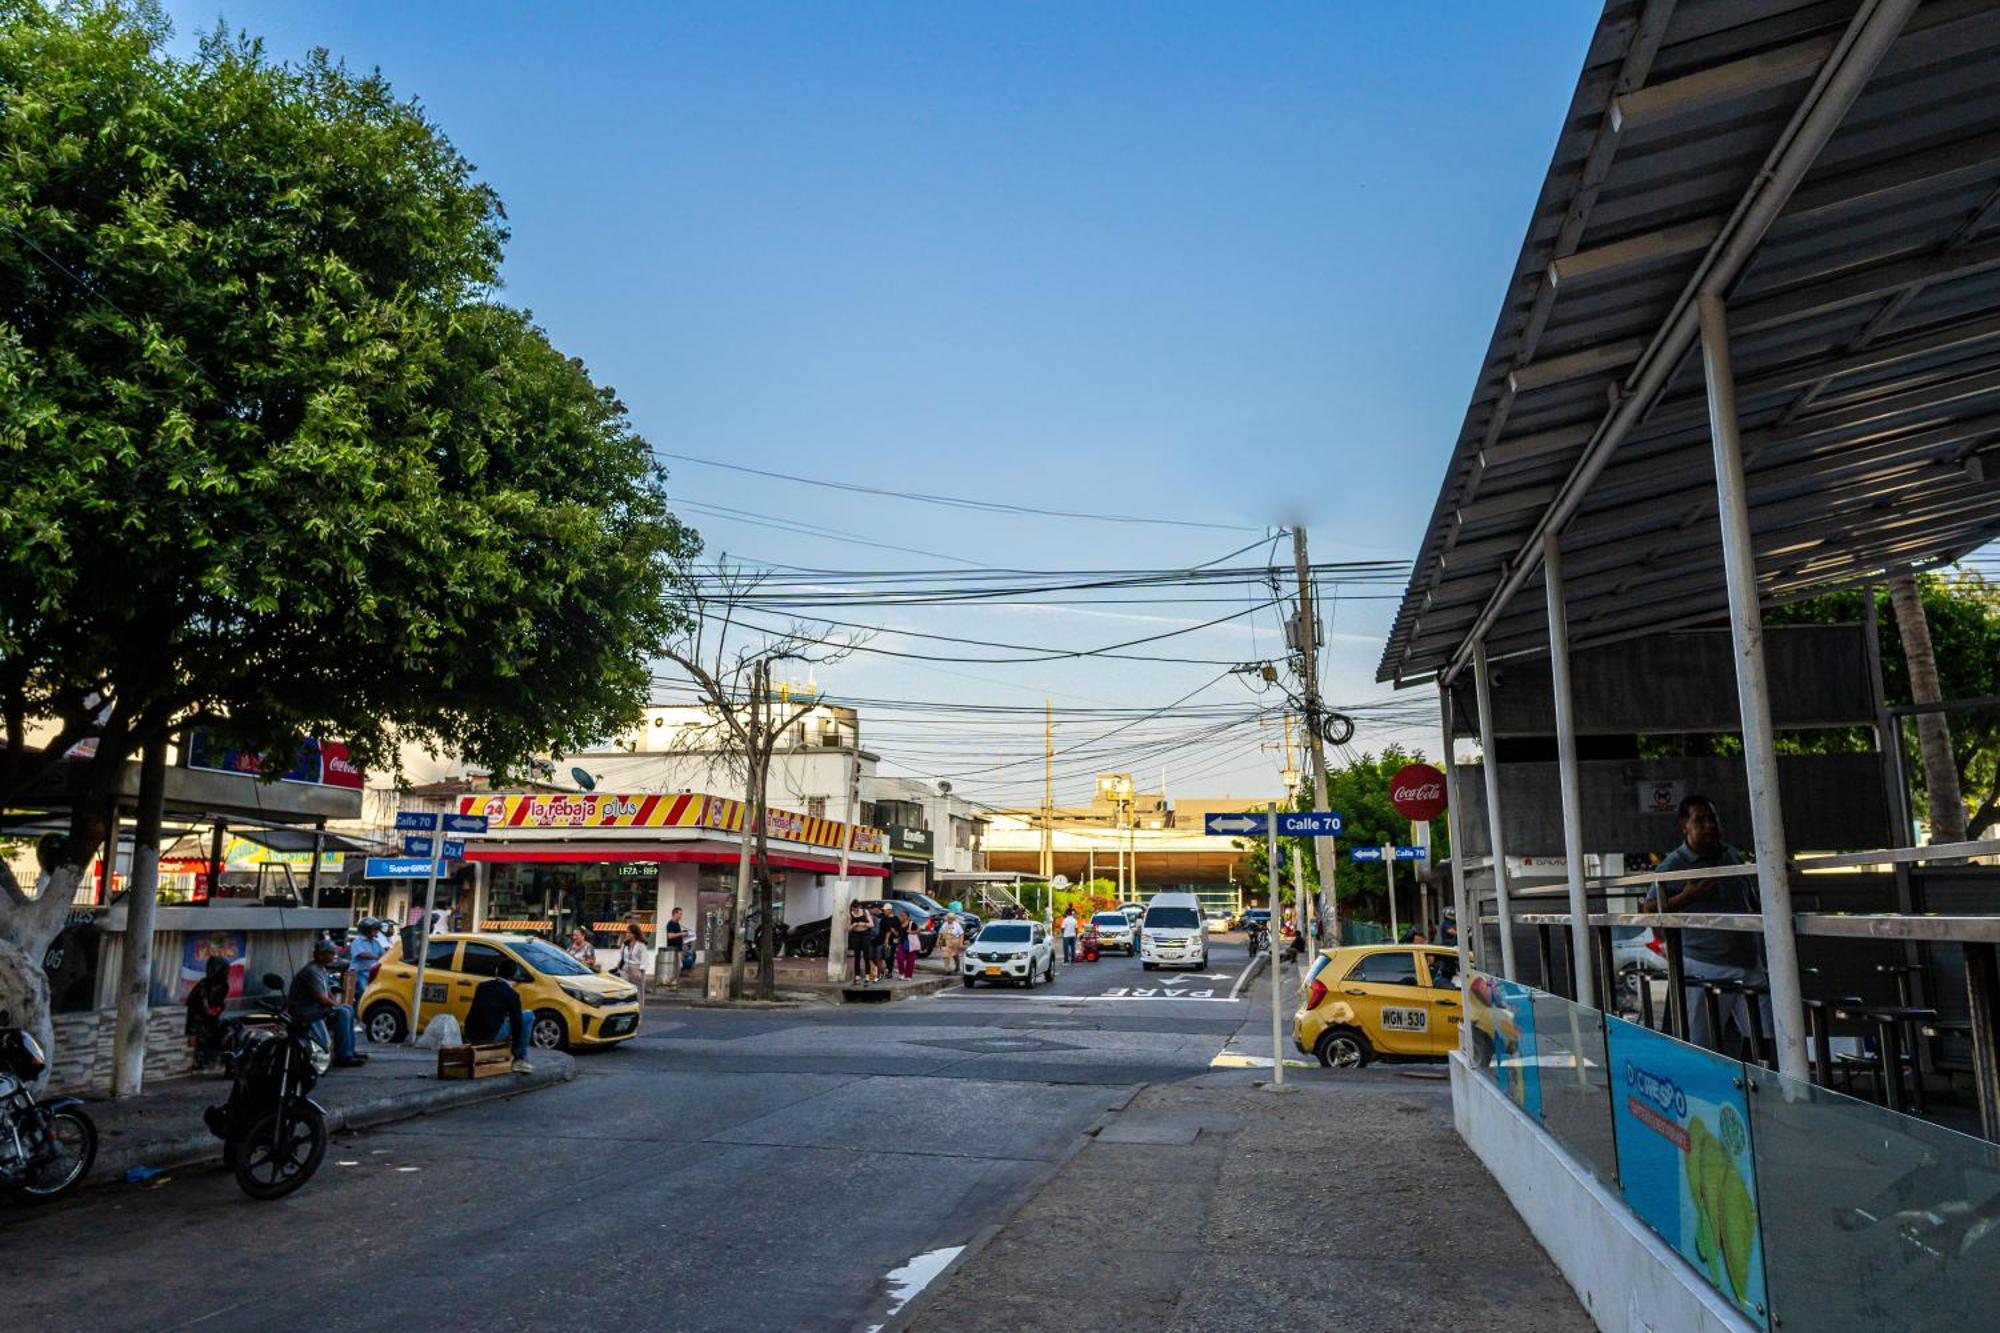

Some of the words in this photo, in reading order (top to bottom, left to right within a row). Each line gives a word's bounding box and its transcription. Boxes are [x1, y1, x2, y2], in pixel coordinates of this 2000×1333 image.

[1394, 783, 1440, 802] Coca-Cola
[487, 803, 504, 816] 24
[531, 802, 544, 816] la
[549, 801, 596, 820] rebaja
[602, 799, 637, 818] plus
[419, 817, 431, 828] 70
[1286, 818, 1320, 831] Calle
[1323, 818, 1341, 830] 70
[1101, 987, 1214, 998] PARE
